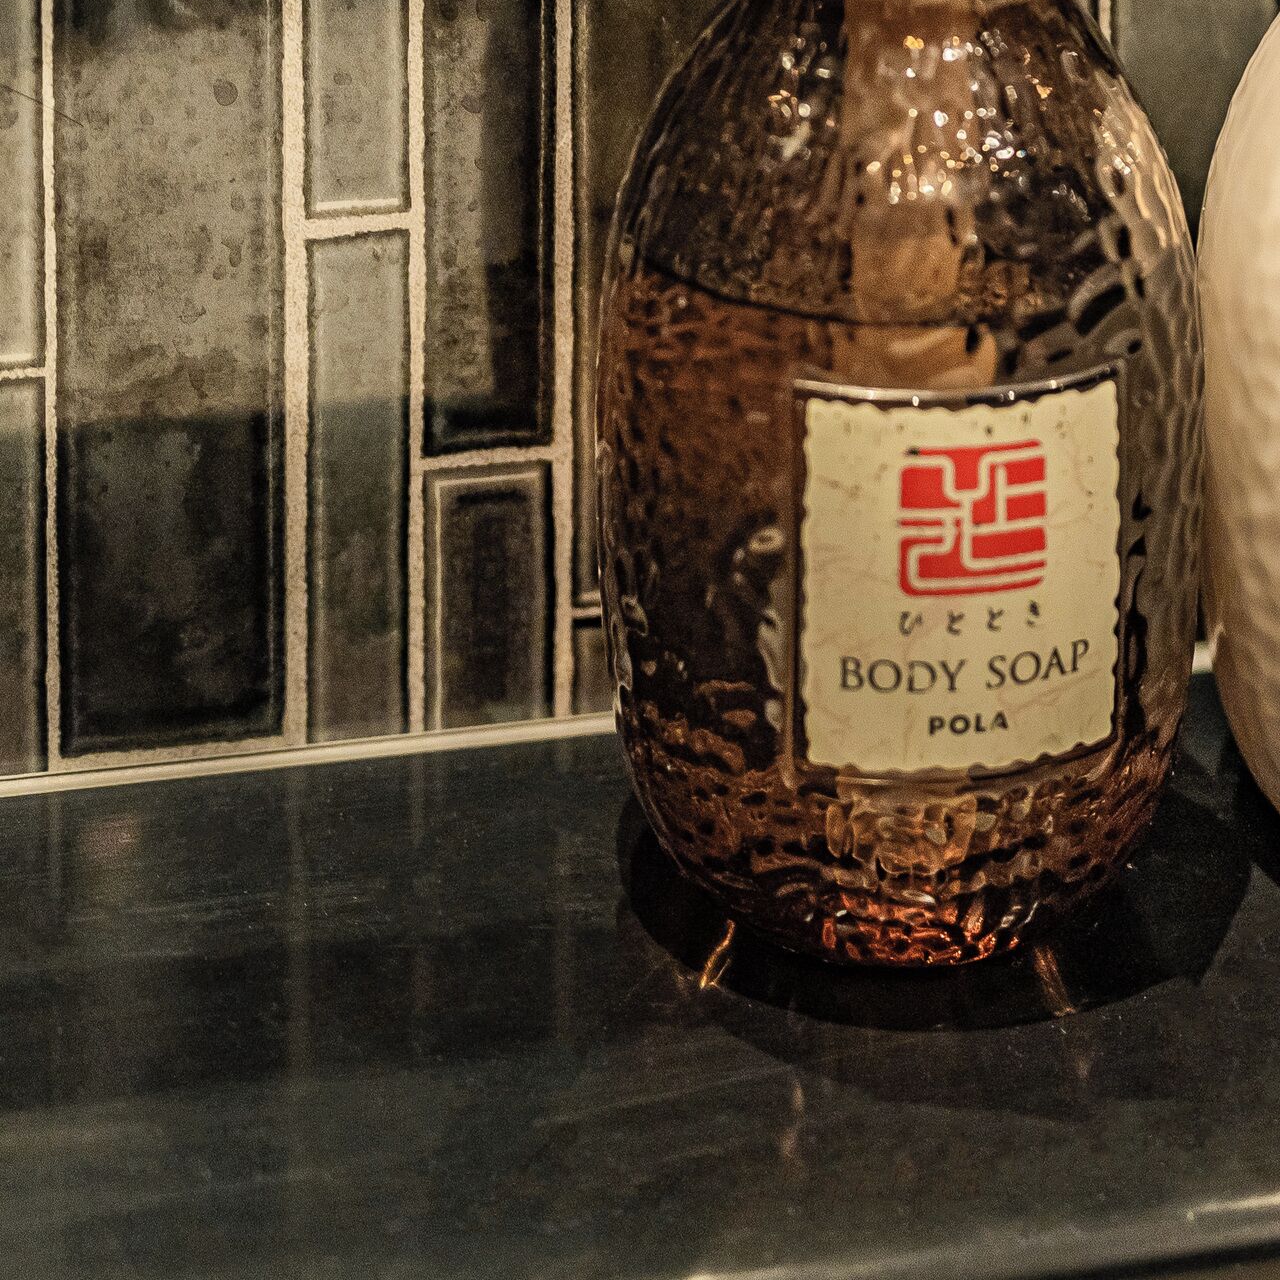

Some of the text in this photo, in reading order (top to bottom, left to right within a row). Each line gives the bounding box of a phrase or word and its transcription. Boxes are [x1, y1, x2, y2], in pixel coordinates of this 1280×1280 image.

[840, 639, 1090, 694] BODY SOAP
[928, 711, 1008, 735] POLA
